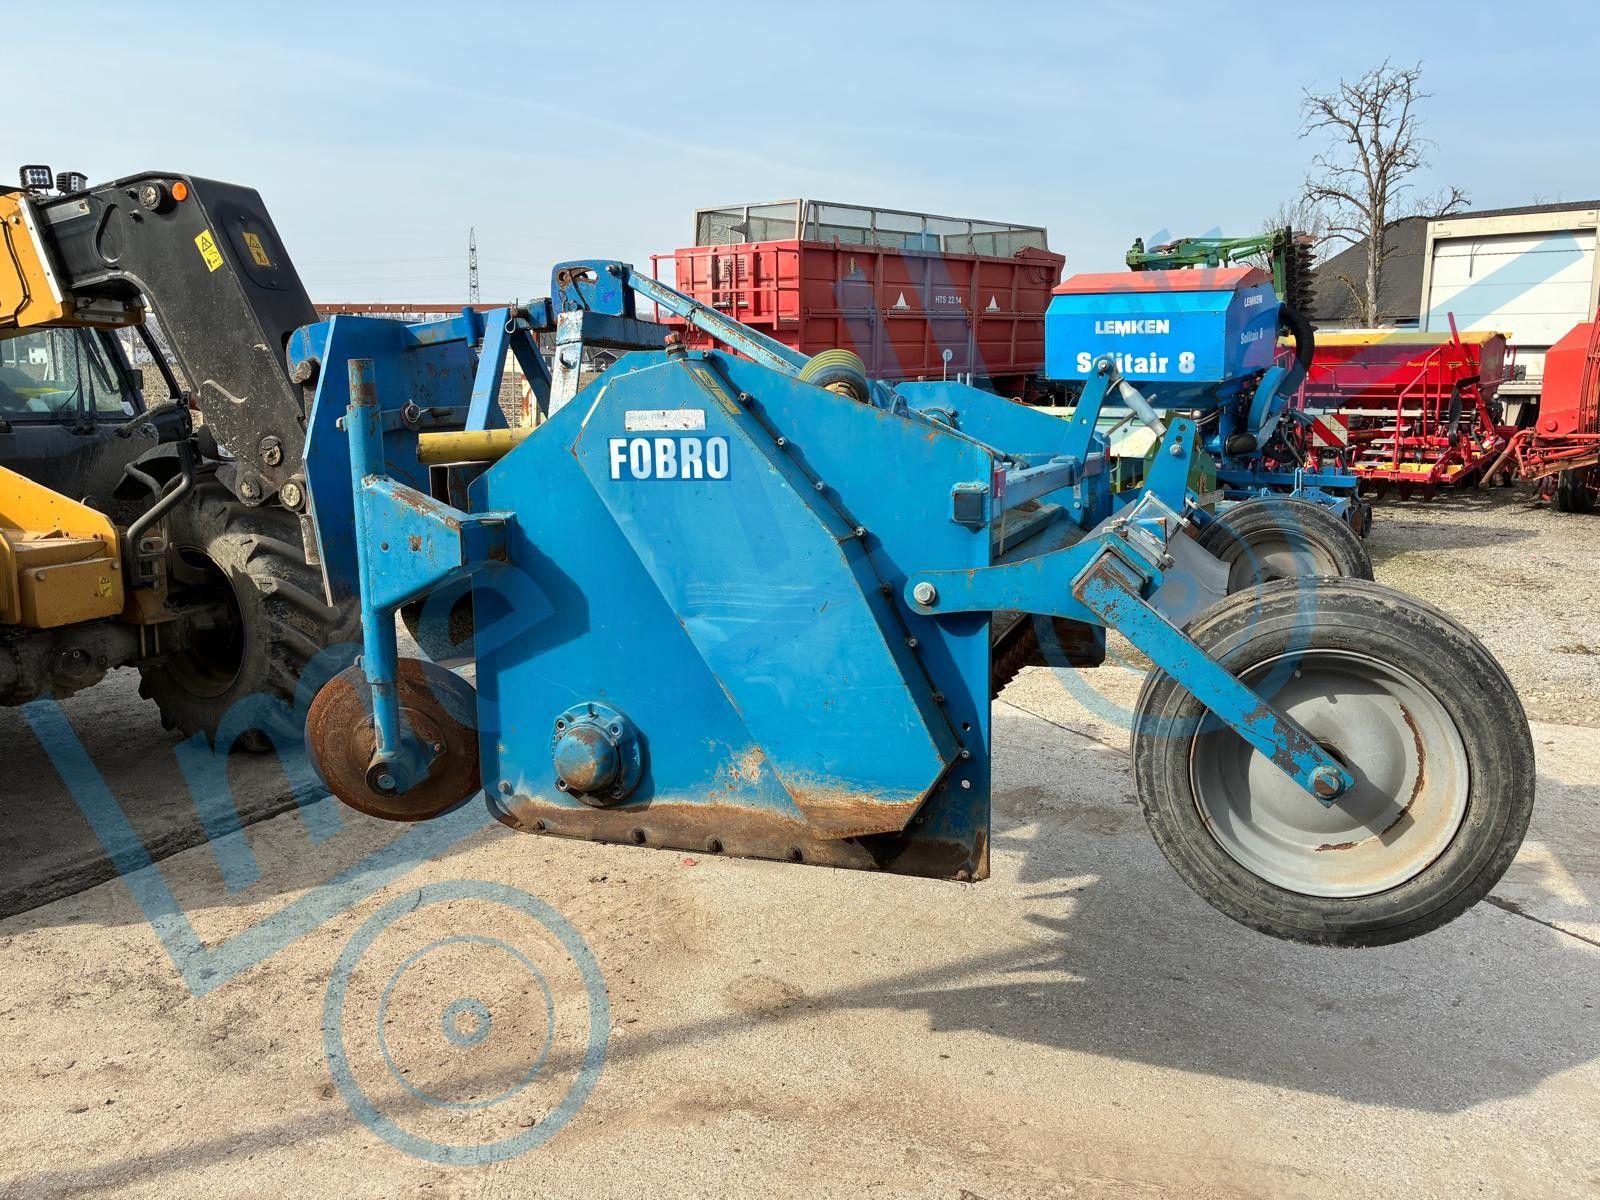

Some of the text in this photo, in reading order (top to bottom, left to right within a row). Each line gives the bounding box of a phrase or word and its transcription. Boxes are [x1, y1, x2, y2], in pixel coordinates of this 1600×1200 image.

[935, 296, 962, 304] HTS 22.14
[1244, 294, 1263, 307] LEMKEN
[1095, 319, 1170, 336] LEMKEN
[1241, 329, 1259, 344] Solitair
[1076, 351, 1195, 374] Sitair 8
[609, 437, 729, 480] FOBRO
